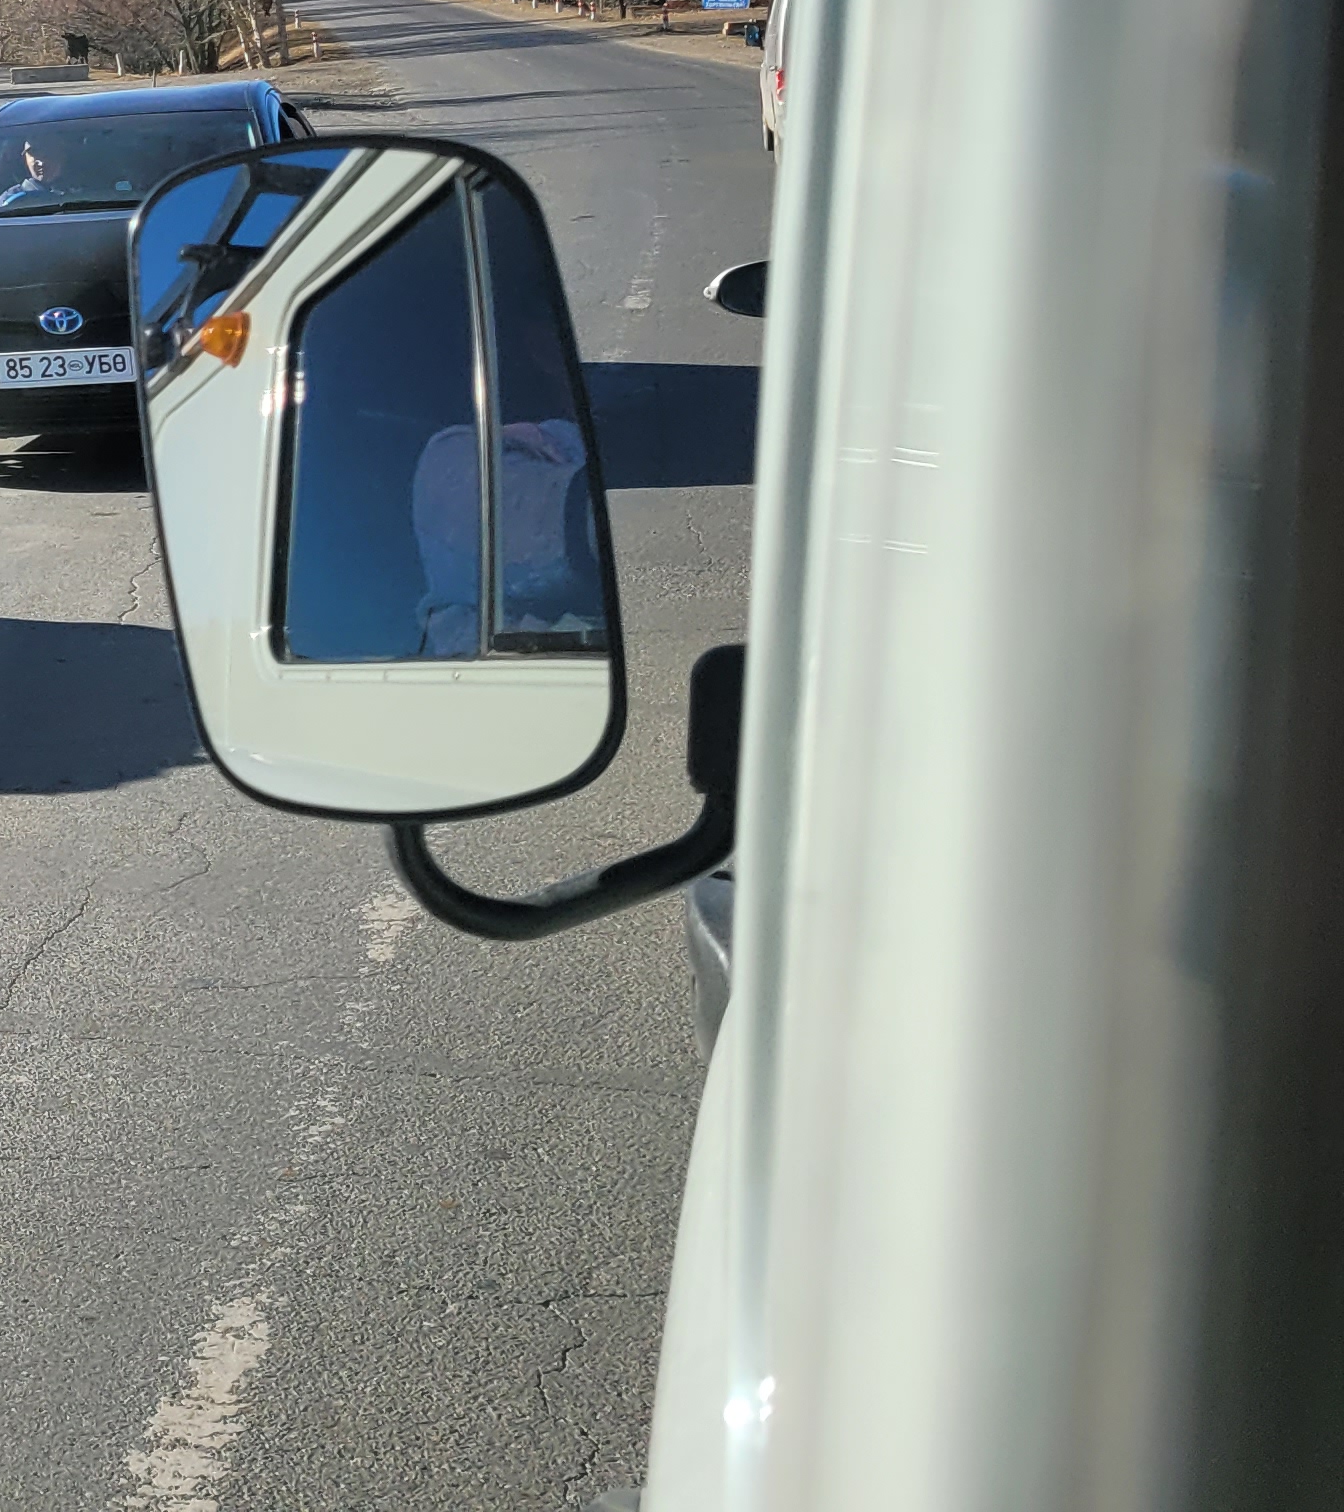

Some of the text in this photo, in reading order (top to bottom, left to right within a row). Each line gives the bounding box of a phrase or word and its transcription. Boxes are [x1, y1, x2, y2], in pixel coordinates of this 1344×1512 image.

[5, 353, 126, 379] 85 23 УБӨ
